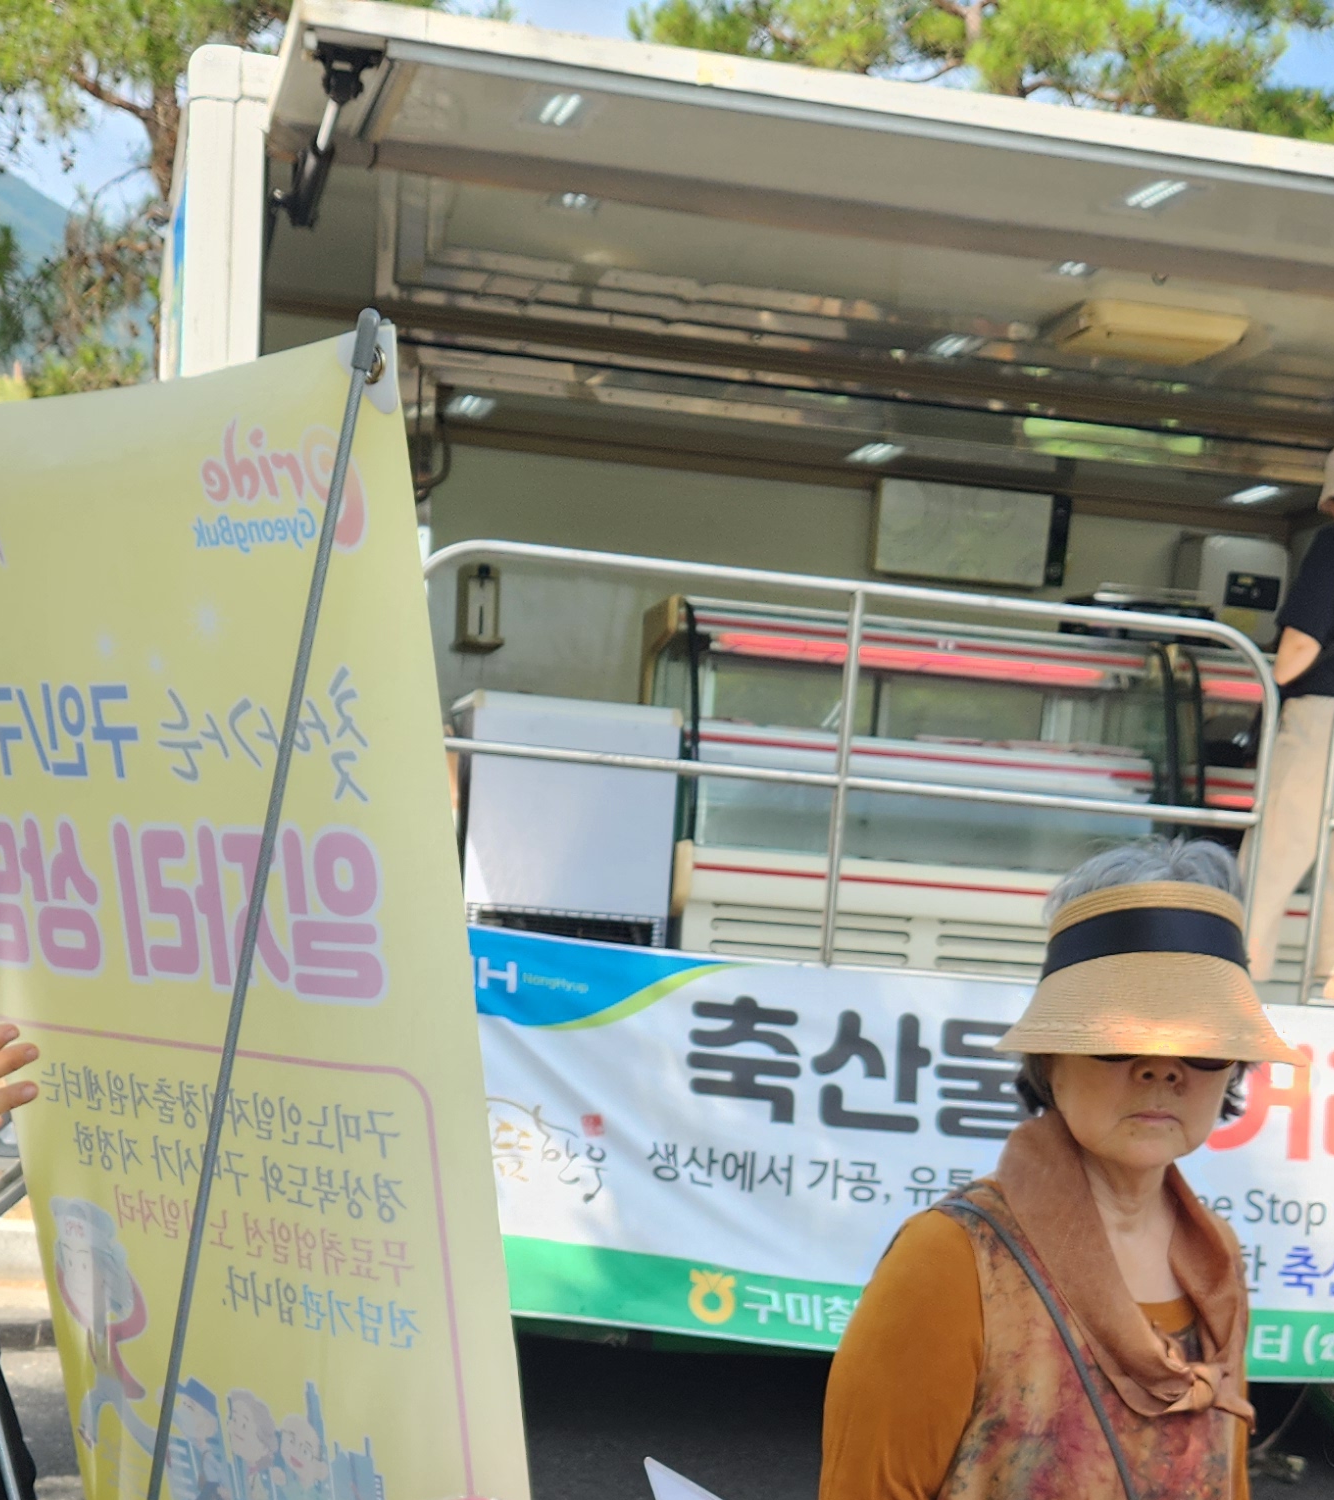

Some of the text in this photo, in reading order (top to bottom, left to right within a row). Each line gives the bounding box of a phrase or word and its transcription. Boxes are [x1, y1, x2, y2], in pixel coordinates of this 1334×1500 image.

[685, 994, 1023, 1141] 축산물
[646, 1140, 794, 1197] 생산에서
[808, 1157, 892, 1206] 가공,
[1243, 1189, 1328, 1236] Stop
